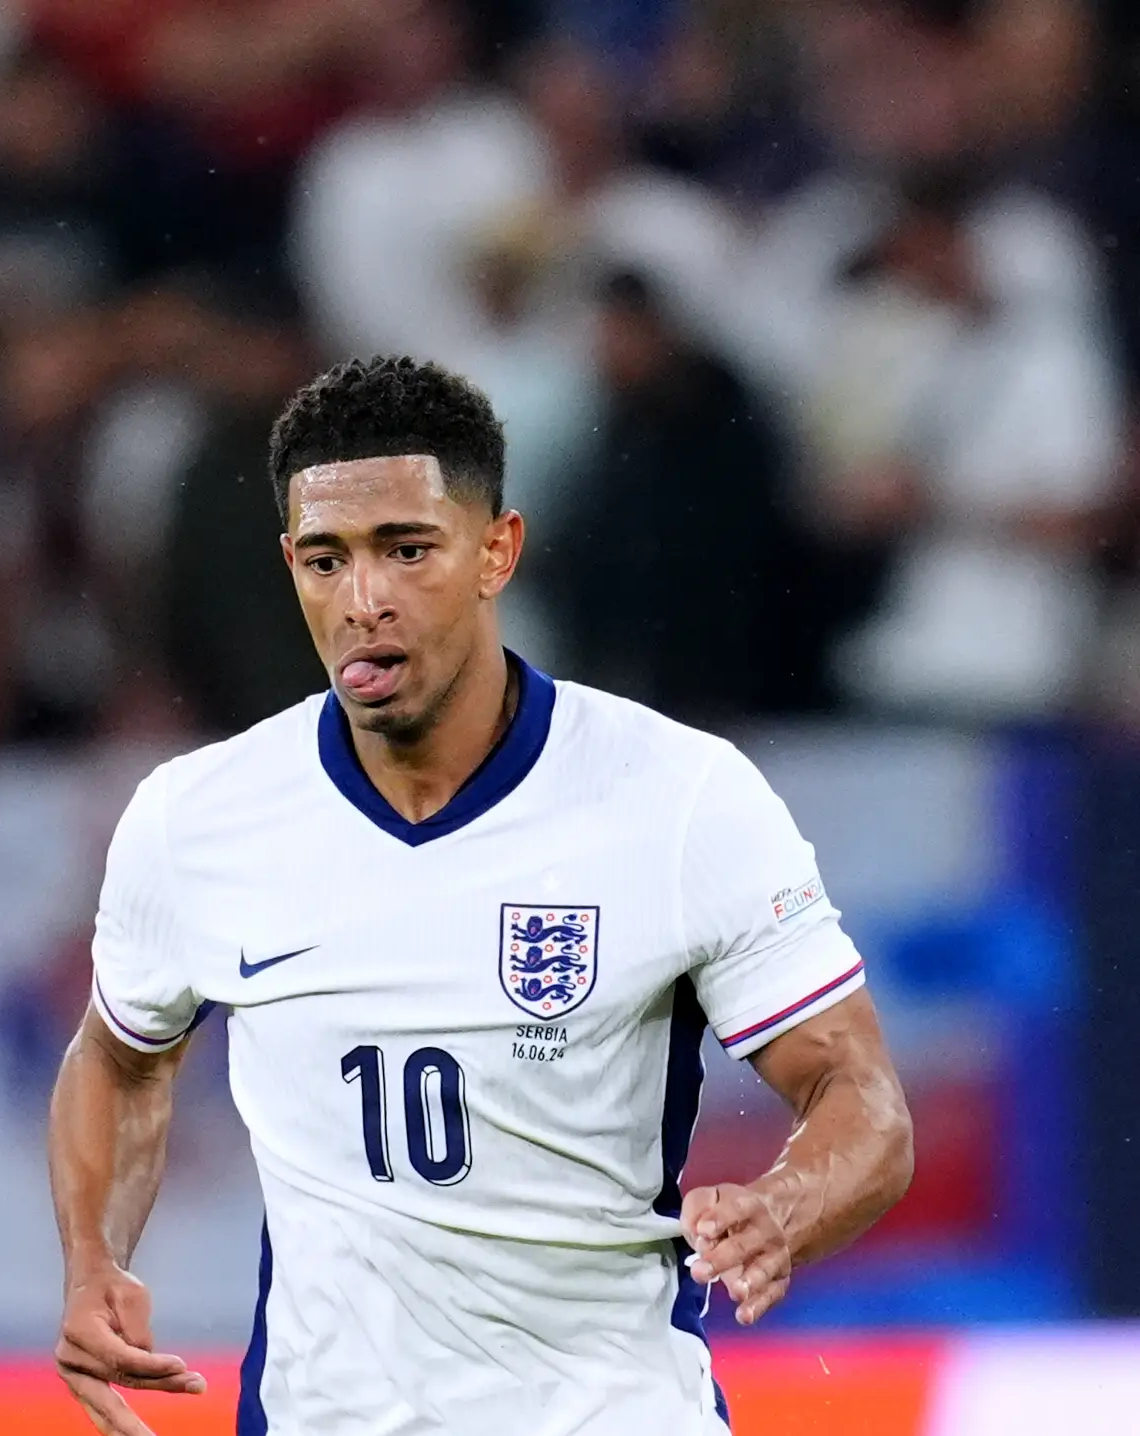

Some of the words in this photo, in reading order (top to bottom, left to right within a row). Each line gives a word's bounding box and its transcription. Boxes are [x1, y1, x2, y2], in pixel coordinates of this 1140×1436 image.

[516, 1024, 568, 1043] SERBIA
[512, 1042, 565, 1062] 16.06.24
[341, 1045, 473, 1187] 10
